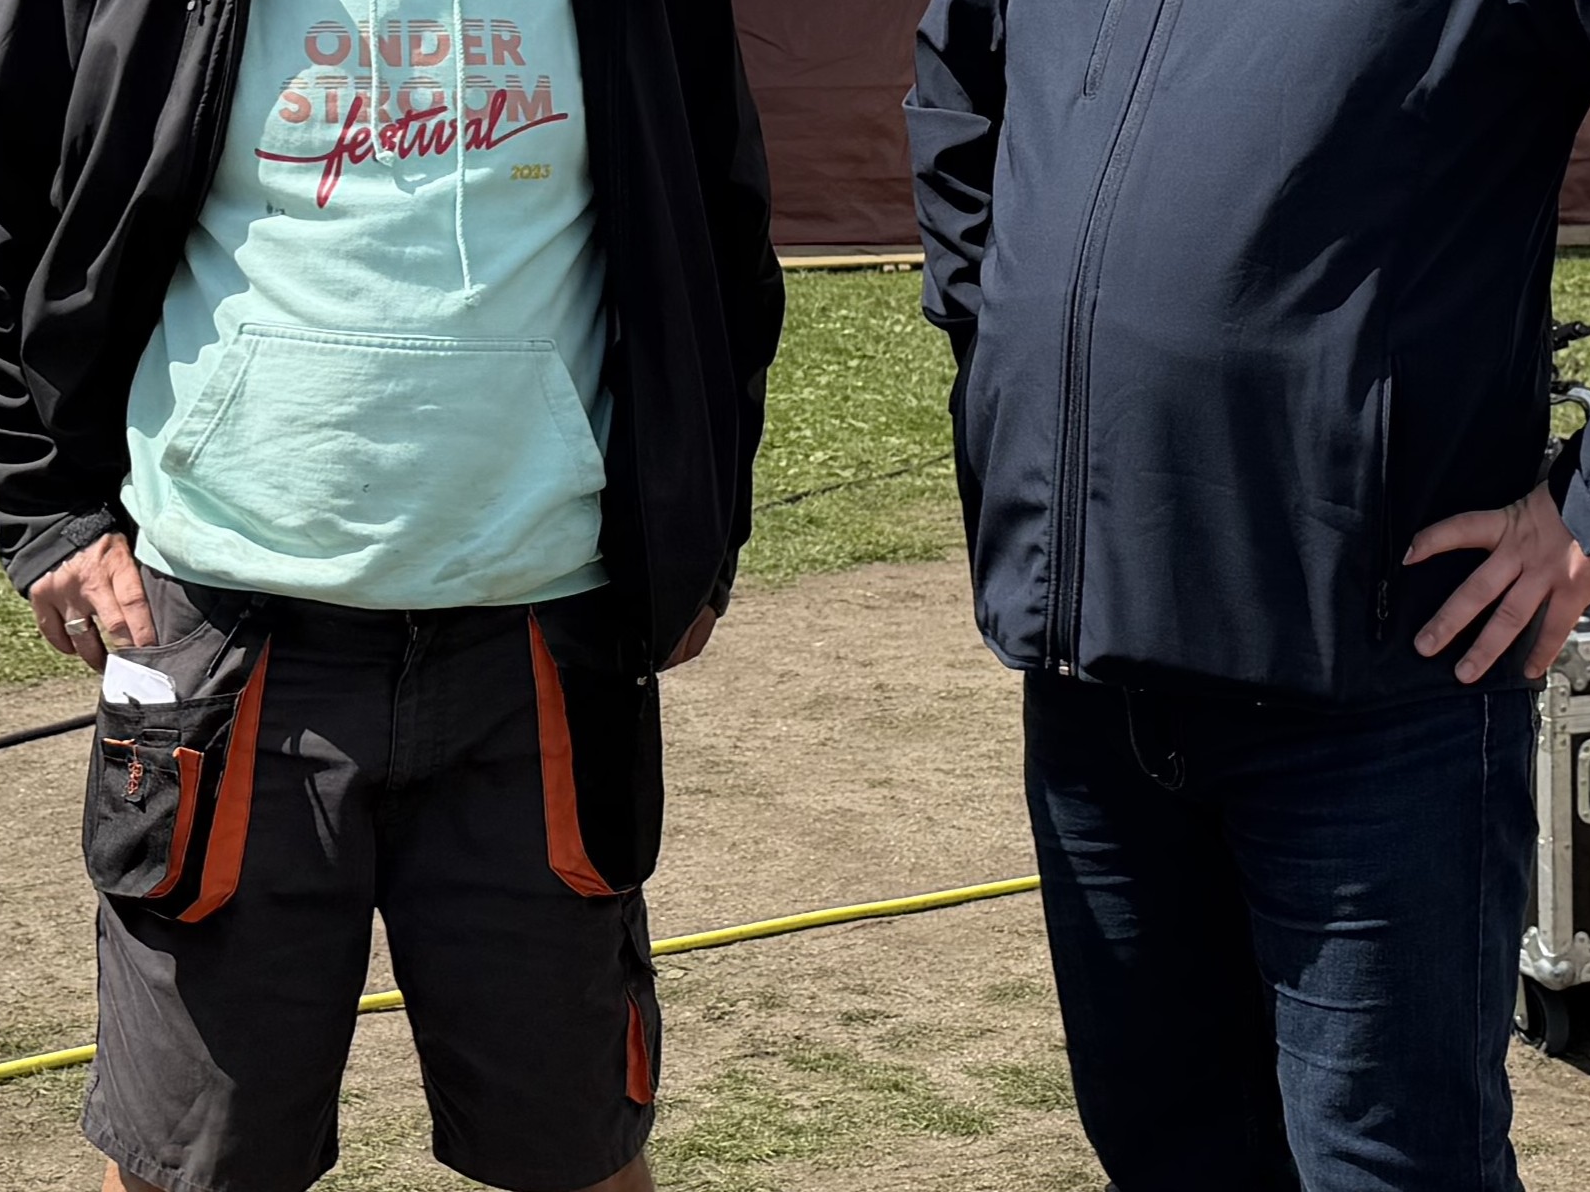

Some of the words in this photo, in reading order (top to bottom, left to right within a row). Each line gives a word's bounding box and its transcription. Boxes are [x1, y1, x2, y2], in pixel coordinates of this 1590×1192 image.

[304, 18, 527, 68] ONDER
[277, 74, 554, 124] STROOM
[254, 89, 569, 209] festival
